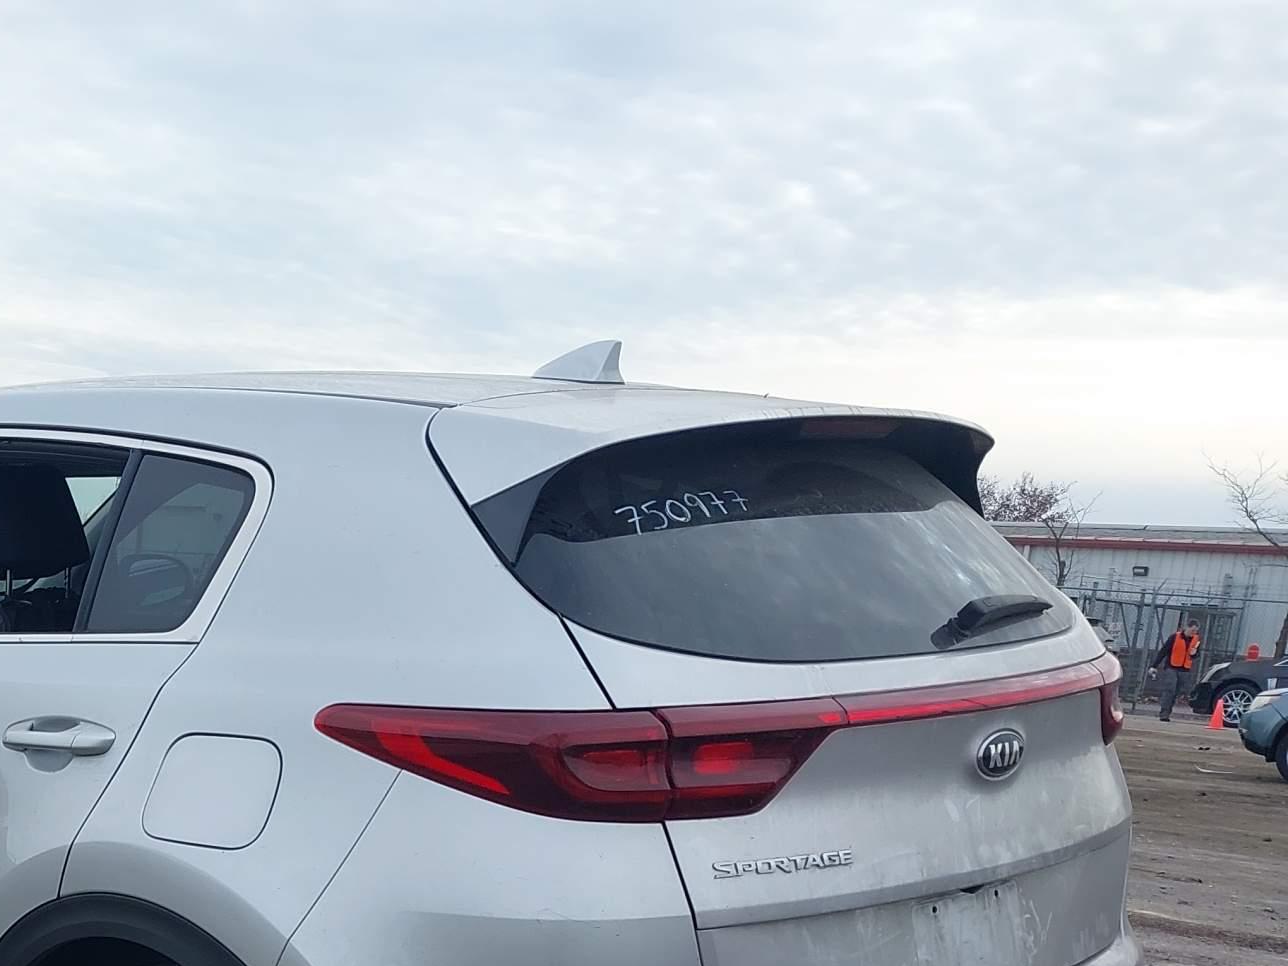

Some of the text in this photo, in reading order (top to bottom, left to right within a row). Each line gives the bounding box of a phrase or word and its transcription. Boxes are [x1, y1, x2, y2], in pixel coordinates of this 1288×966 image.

[613, 490, 749, 536] 750977
[987, 740, 1021, 769] KIA
[712, 848, 854, 879] SPORTAGE
